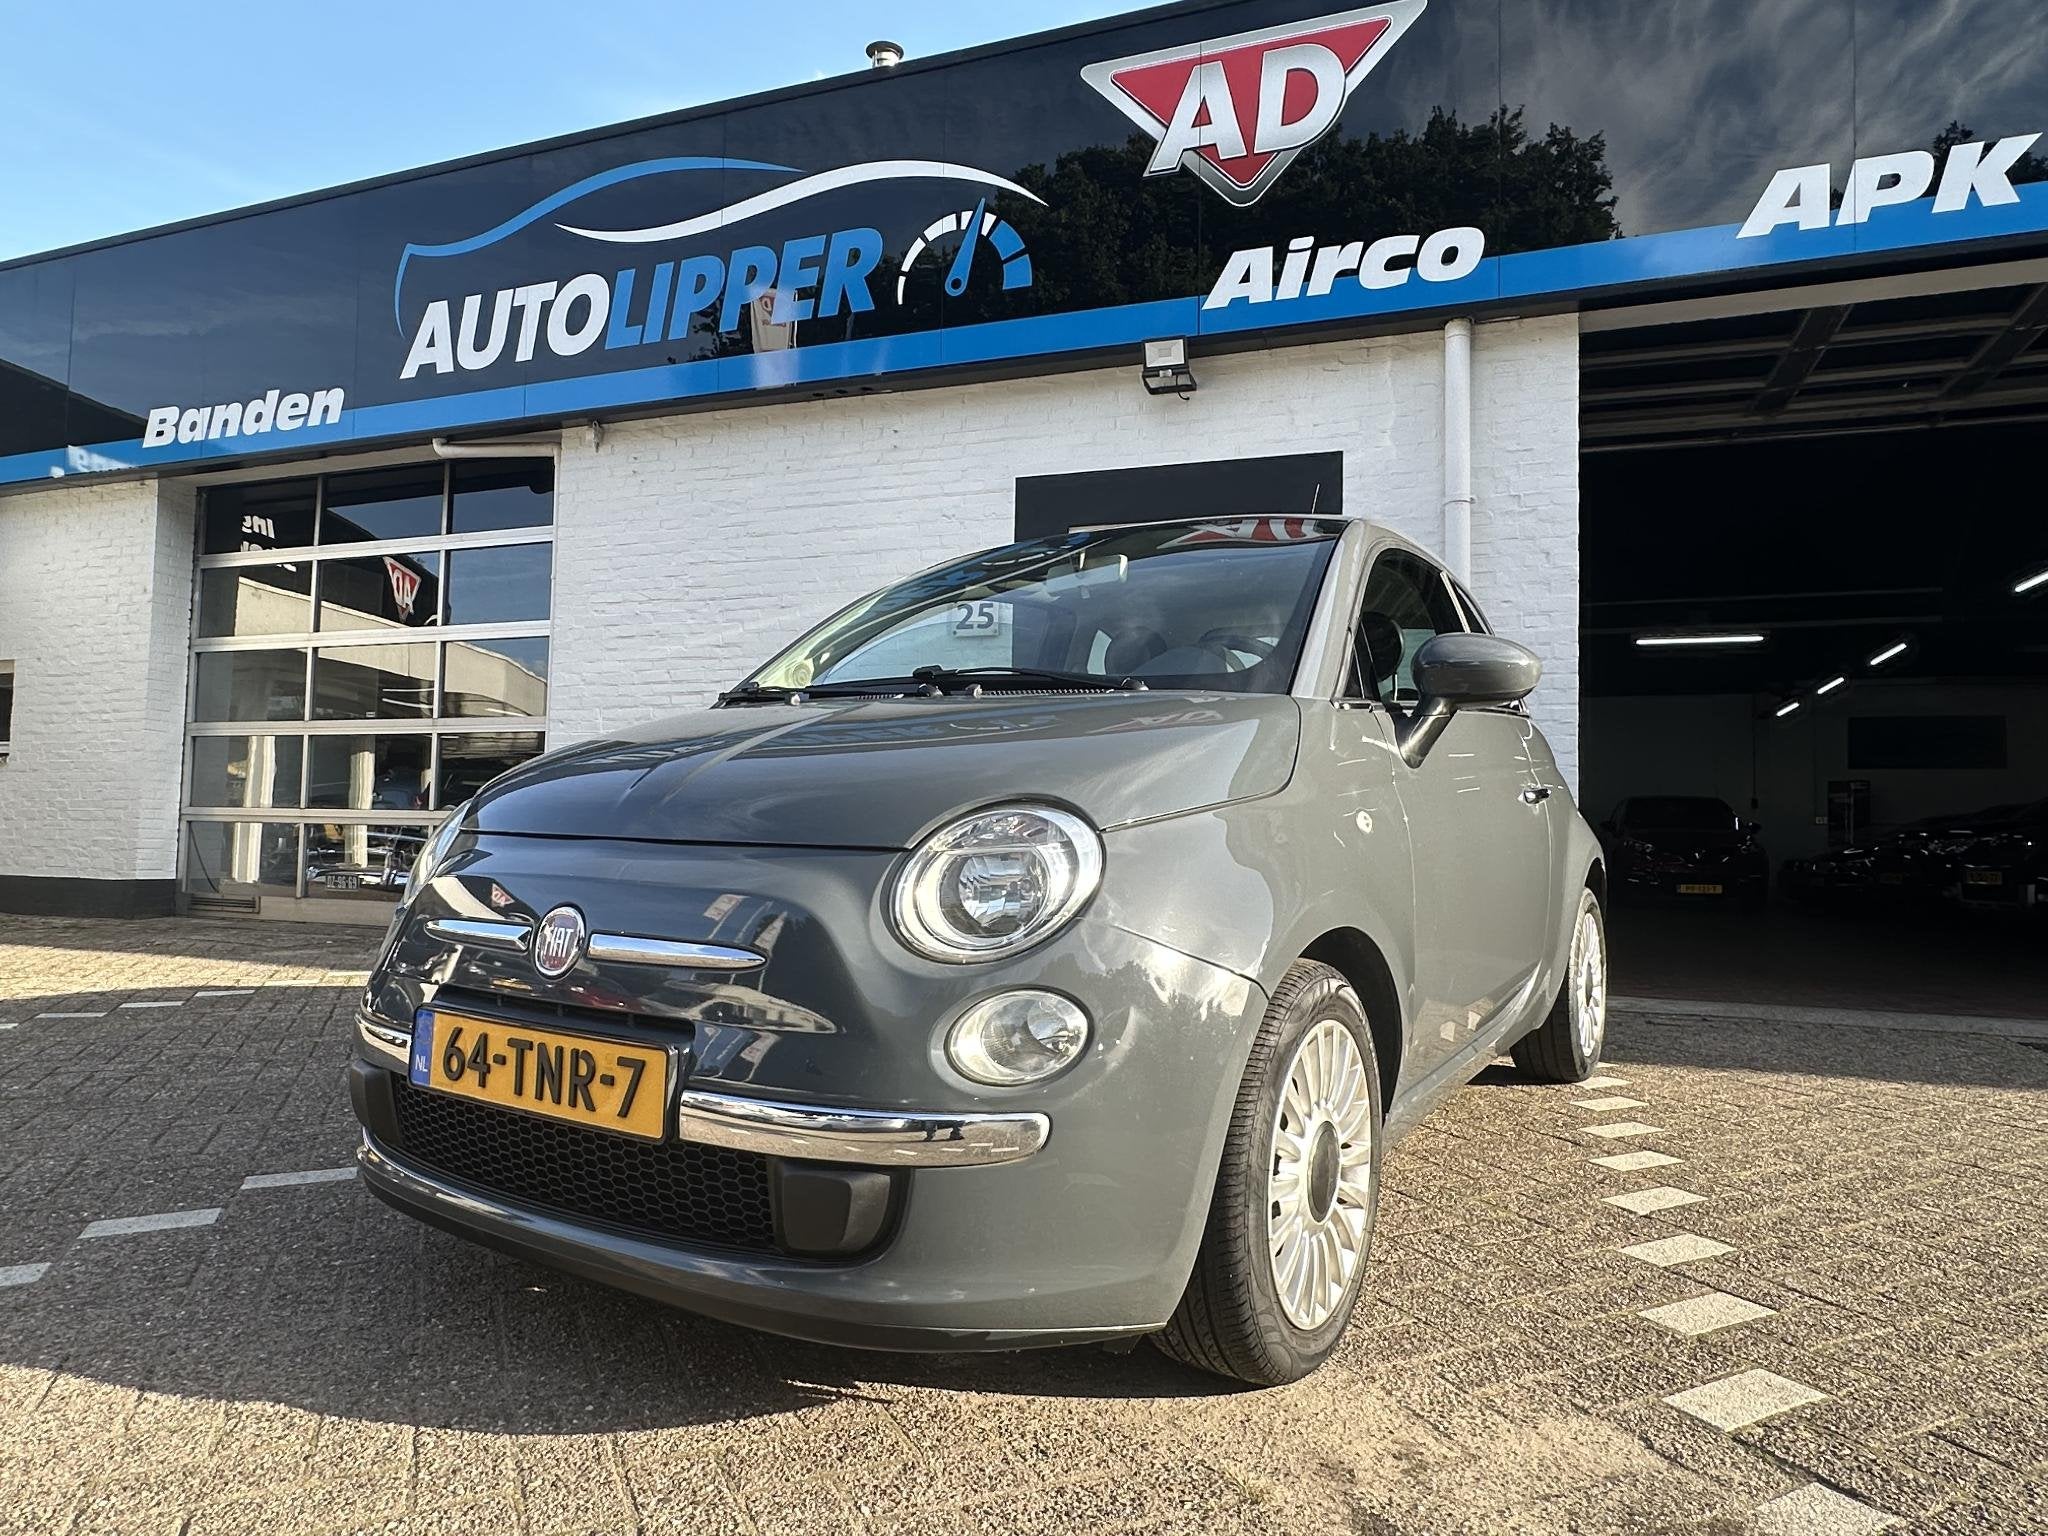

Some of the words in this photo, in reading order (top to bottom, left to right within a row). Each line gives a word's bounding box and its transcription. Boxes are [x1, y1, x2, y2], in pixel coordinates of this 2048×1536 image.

[1147, 44, 1346, 174] AD
[1736, 132, 2043, 239] APK
[400, 227, 883, 379] AUTOLIPPER
[1201, 226, 1485, 310] Airco
[142, 387, 345, 448] Banden
[956, 602, 995, 630] 25
[543, 926, 575, 958] FIAT
[414, 1053, 429, 1073] NL
[443, 1026, 646, 1118] 64-TNR-7
